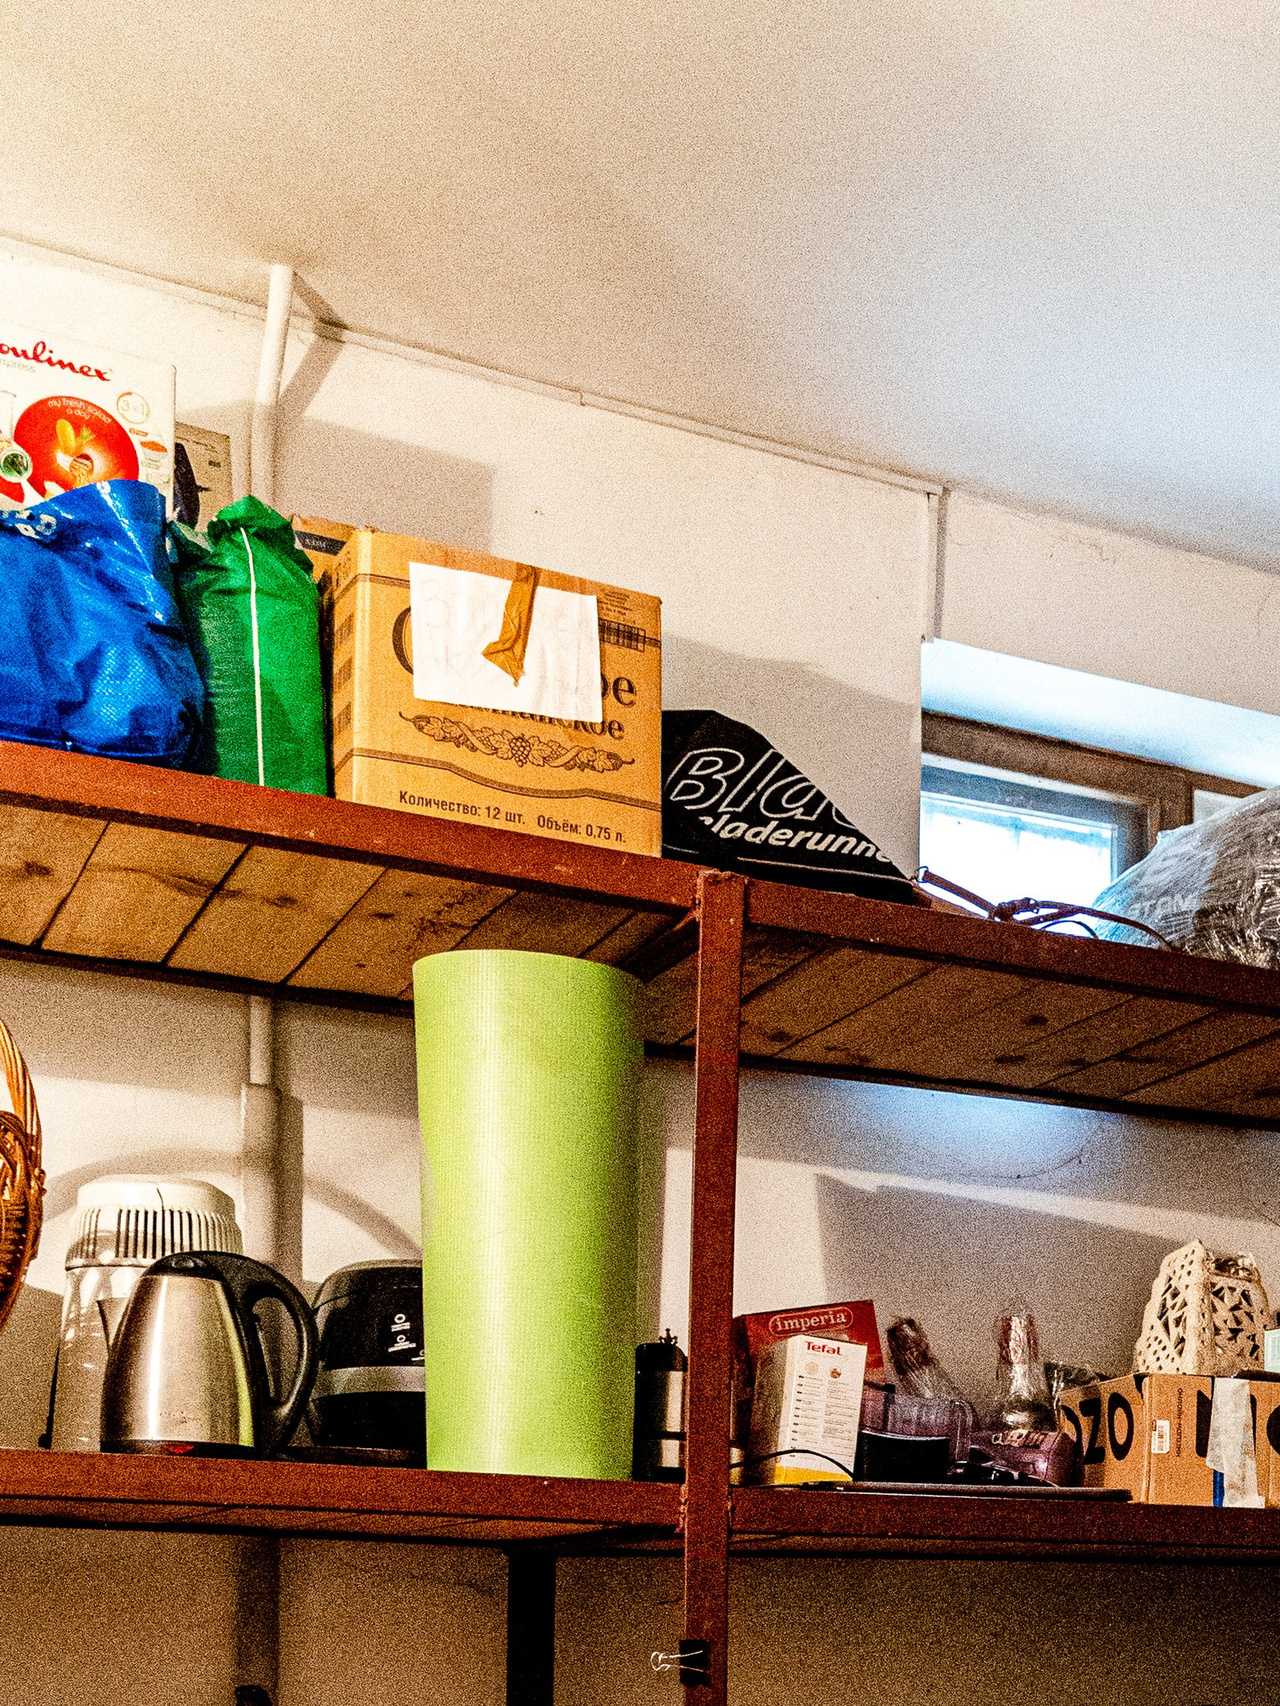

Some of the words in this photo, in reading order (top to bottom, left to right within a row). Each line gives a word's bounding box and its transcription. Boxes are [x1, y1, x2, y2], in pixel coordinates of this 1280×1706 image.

[62, 397, 87, 412] fresh
[88, 406, 113, 424] salad
[399, 790, 481, 817] Количество:
[484, 805, 501, 820] 12
[505, 811, 526, 826] шт.
[537, 814, 582, 836] Объём:
[585, 823, 611, 842] 0,75
[614, 830, 627, 844] л.
[775, 1311, 848, 1332] imperia
[804, 1340, 843, 1356] Tefal
